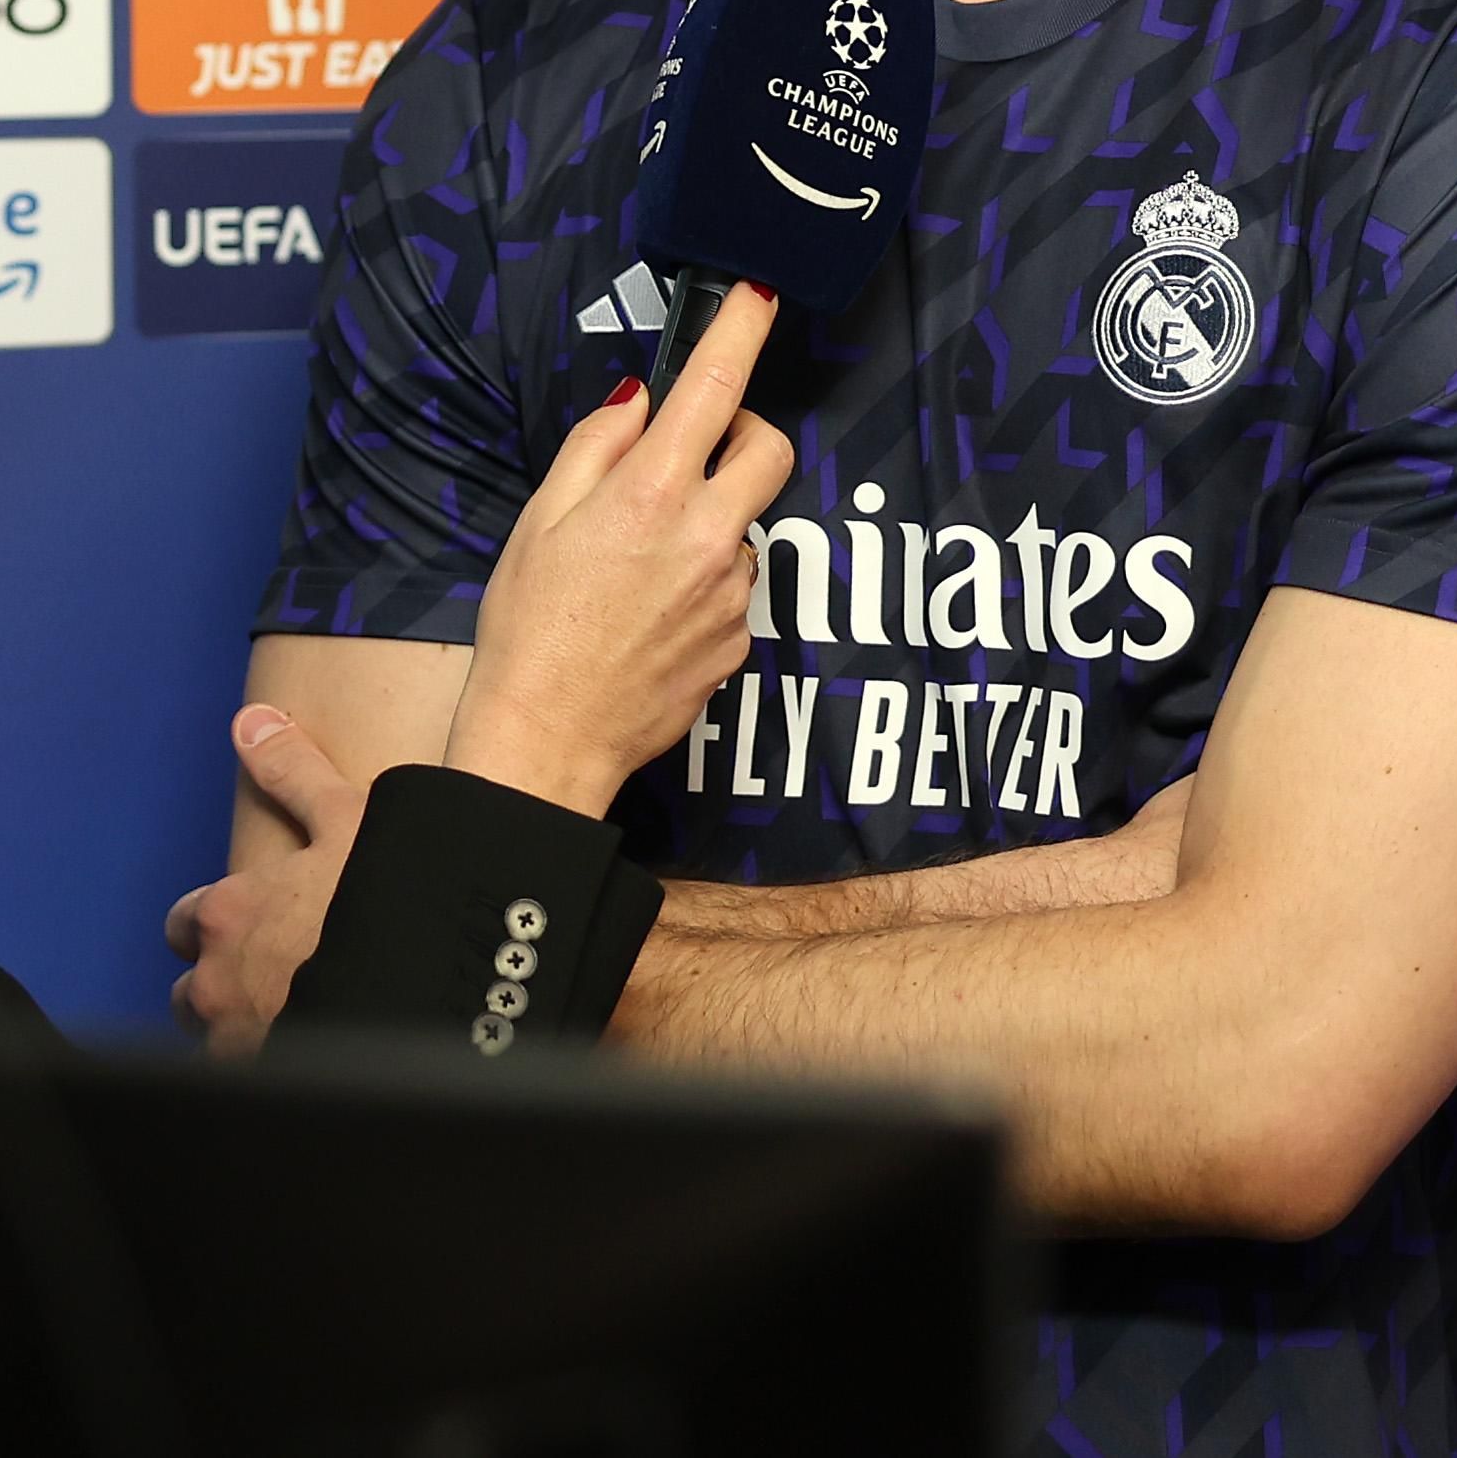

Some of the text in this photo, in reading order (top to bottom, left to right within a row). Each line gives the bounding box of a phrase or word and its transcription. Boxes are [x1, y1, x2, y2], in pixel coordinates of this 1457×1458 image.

[190, 38, 404, 98] JUST EA
[823, 74, 865, 101] UEFA
[767, 78, 899, 146] CHAMPIONS
[787, 108, 876, 160] LEAGUE
[153, 205, 324, 268] UEFA
[746, 482, 1195, 661] mirates
[687, 672, 1084, 818] FLY BETTER
